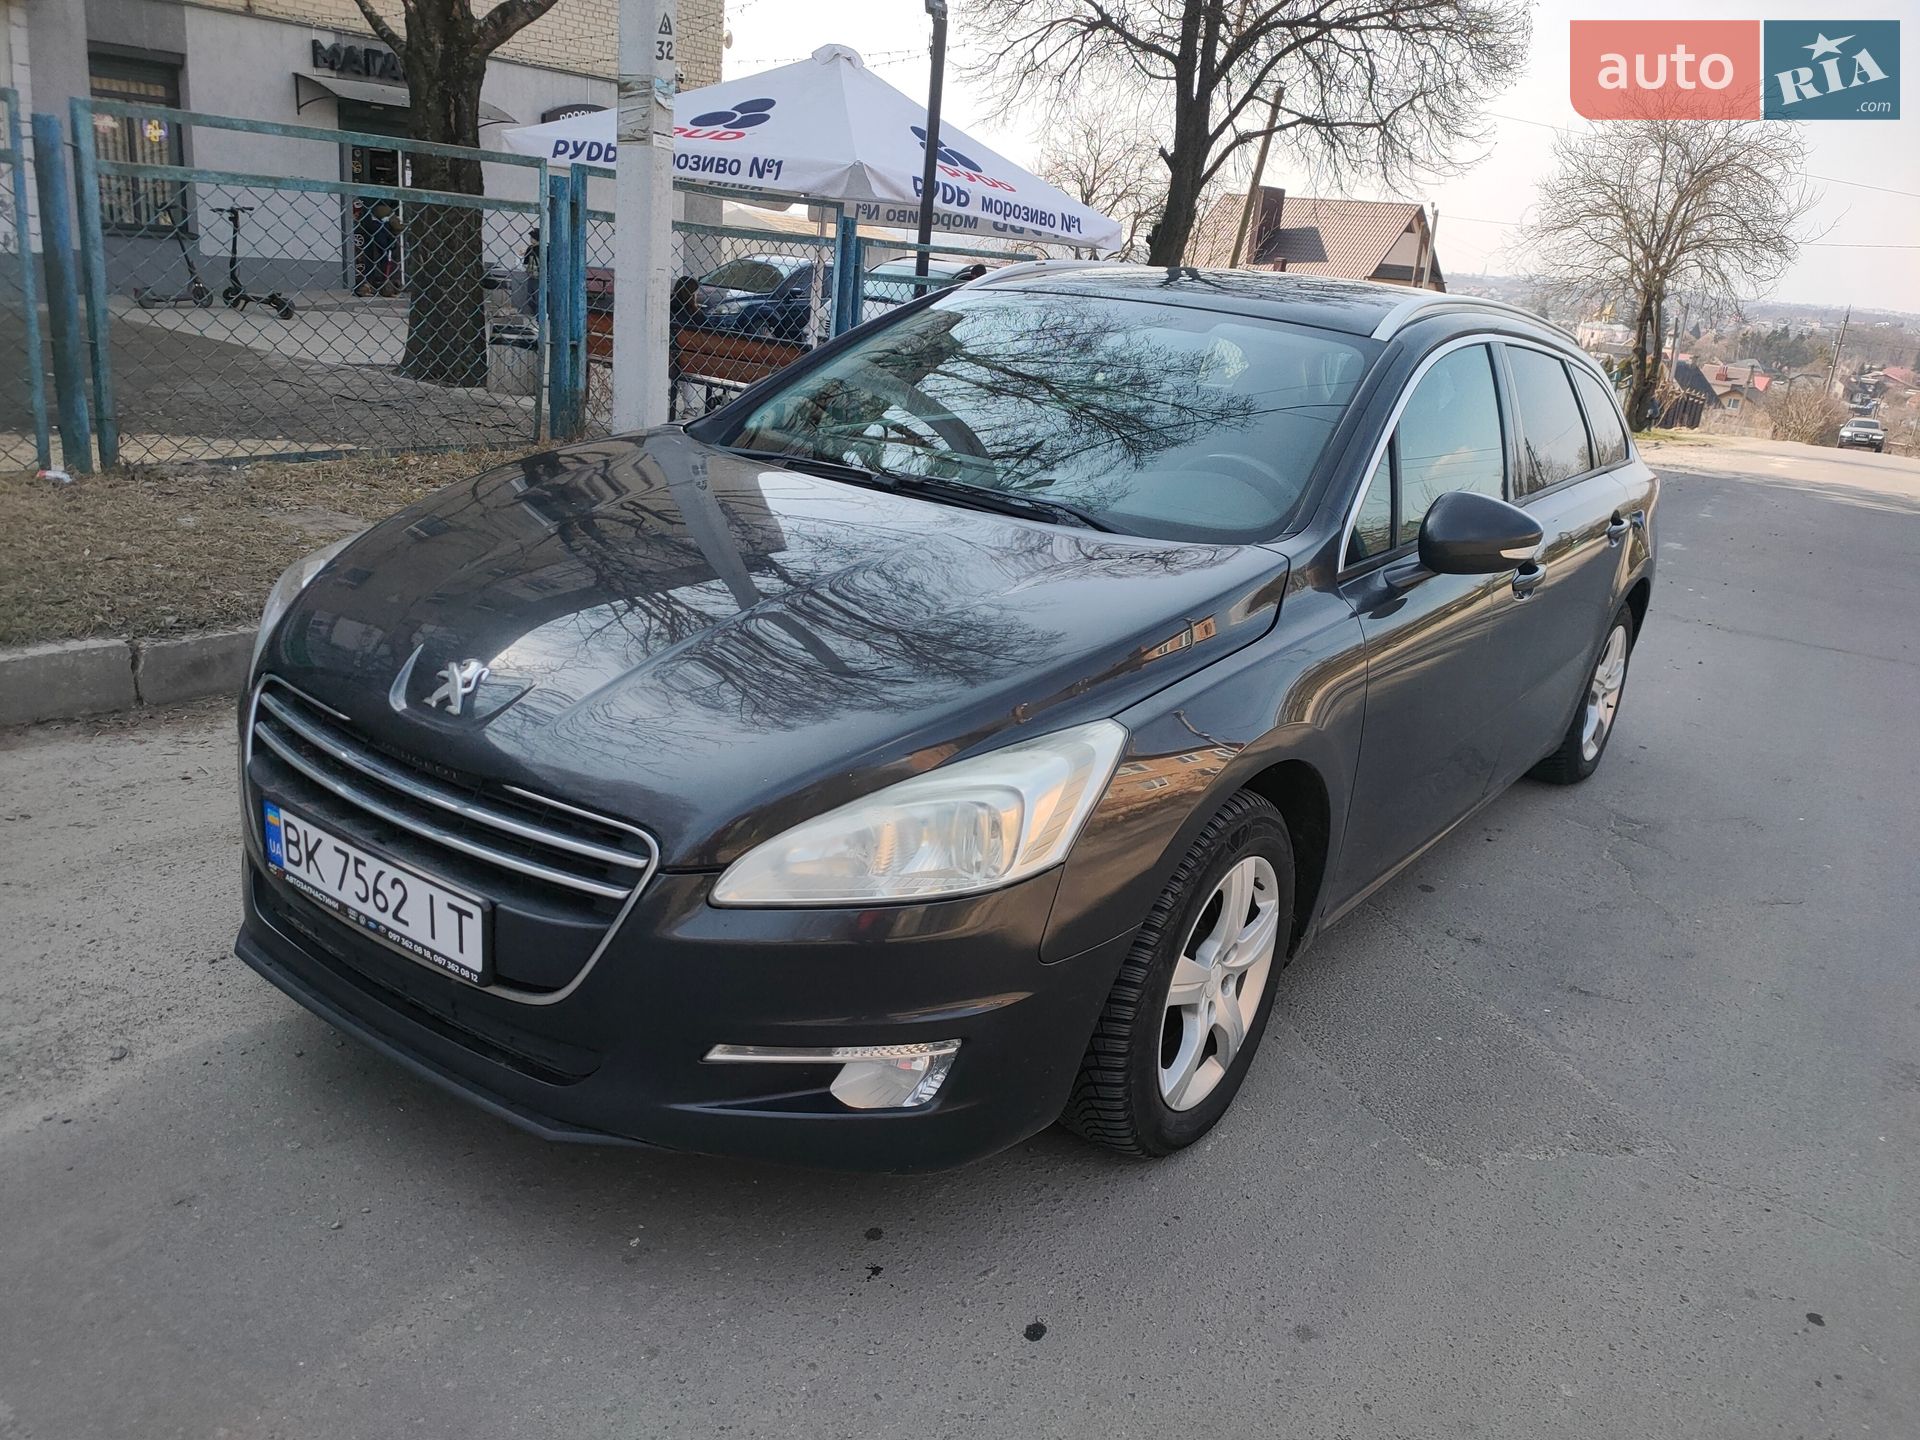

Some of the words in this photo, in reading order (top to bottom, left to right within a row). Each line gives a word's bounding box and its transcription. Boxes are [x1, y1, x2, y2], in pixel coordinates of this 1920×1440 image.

[655, 41, 674, 60] 32
[269, 838, 282, 855] UA
[284, 818, 326, 884] BK
[333, 845, 409, 927] 7562
[429, 893, 474, 955] IT
[387, 930, 400, 943] 097
[401, 937, 413, 950] 362
[447, 960, 460, 974] 362
[470, 972, 479, 983] 12
